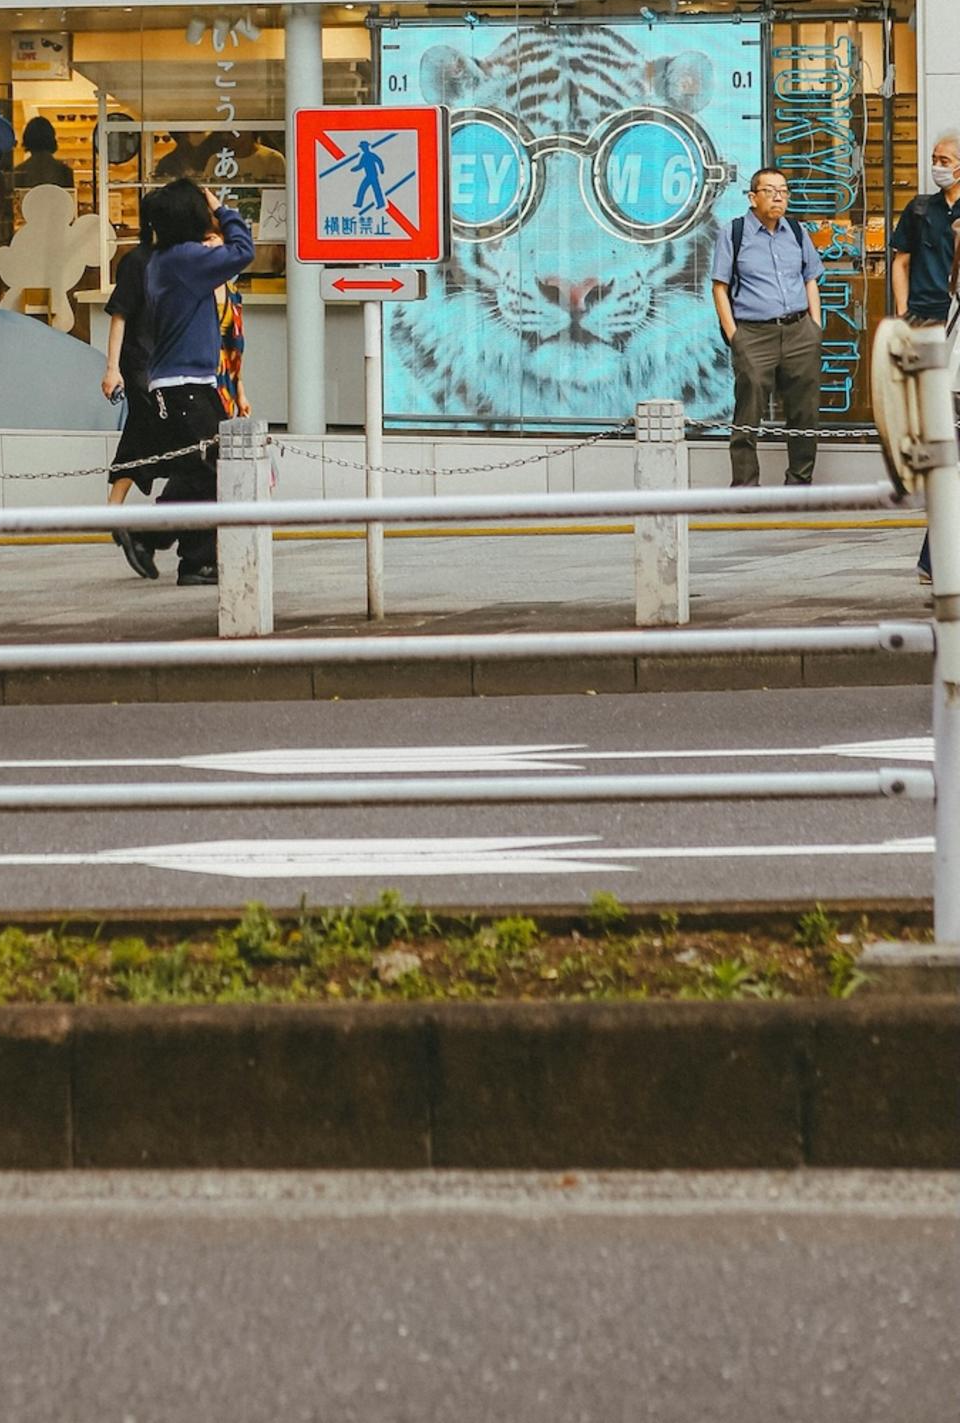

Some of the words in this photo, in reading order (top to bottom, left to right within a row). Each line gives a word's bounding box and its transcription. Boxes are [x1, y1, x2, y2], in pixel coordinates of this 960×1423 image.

[388, 74, 408, 92] 0.1
[732, 70, 753, 89] 0.1
[772, 36, 856, 213] TOKYO
[324, 216, 391, 235] 横断禁止
